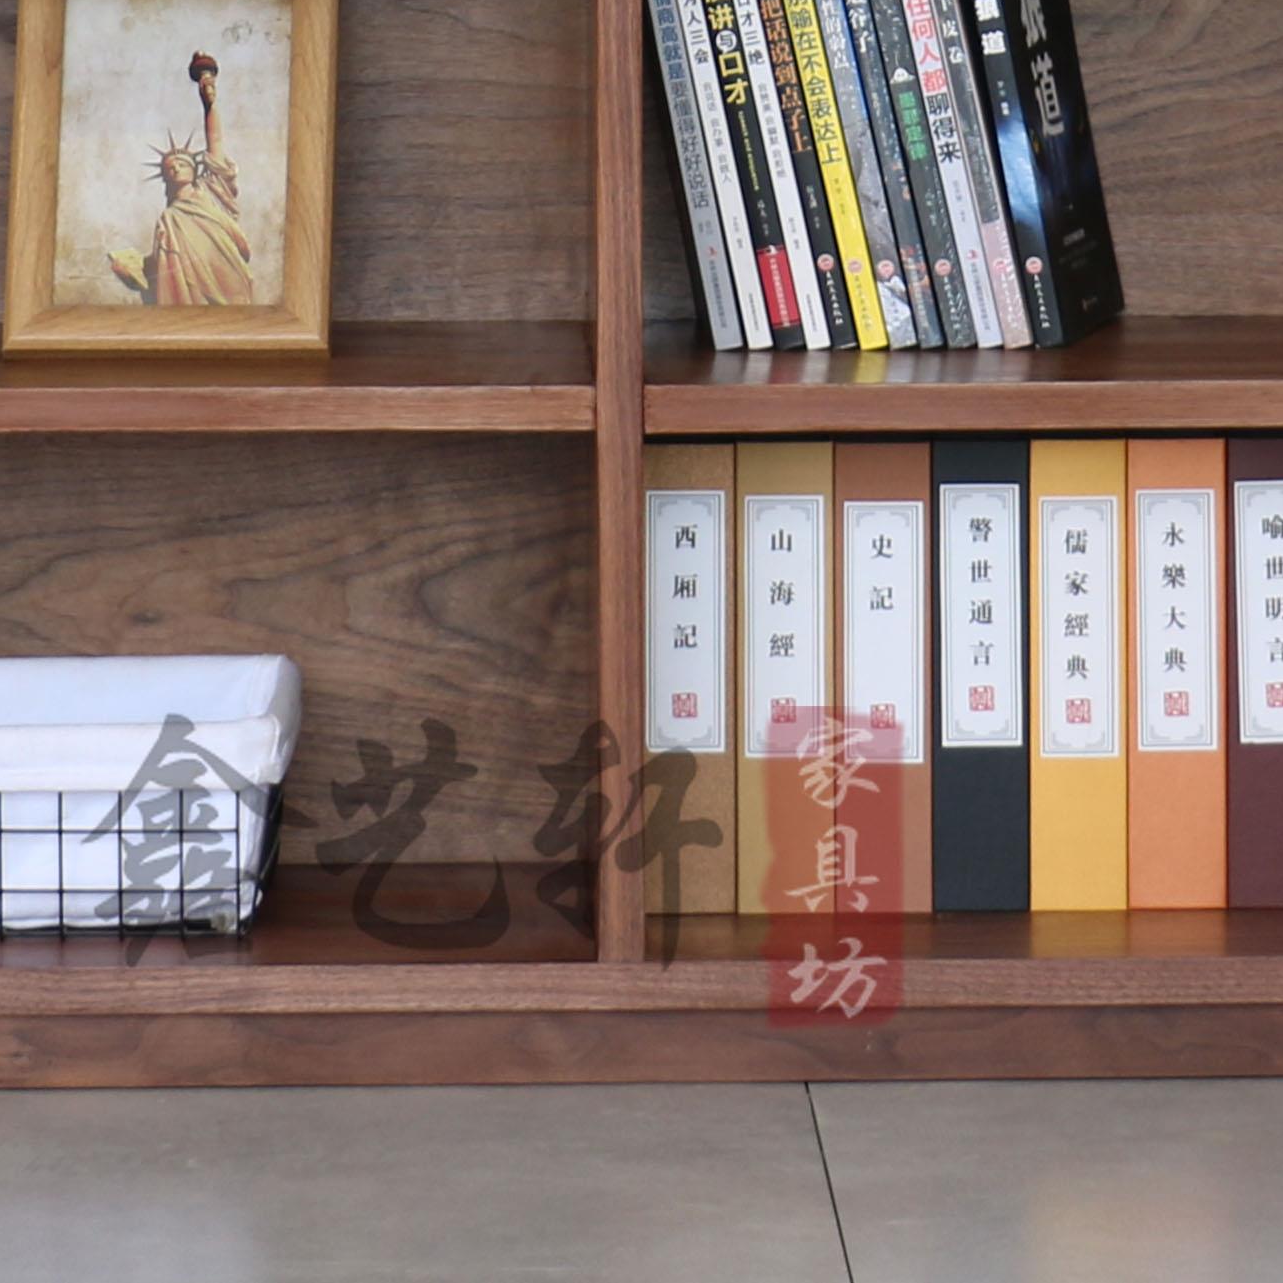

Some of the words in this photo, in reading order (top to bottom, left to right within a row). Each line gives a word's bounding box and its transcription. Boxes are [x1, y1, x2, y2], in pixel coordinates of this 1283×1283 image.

[671, 524, 699, 650] 西厢記
[768, 529, 796, 659] 山海經
[868, 534, 894, 612] 史記
[969, 516, 994, 667] 警世通言
[1063, 528, 1090, 681] 儒家經典
[1162, 521, 1187, 673] 永樂大典
